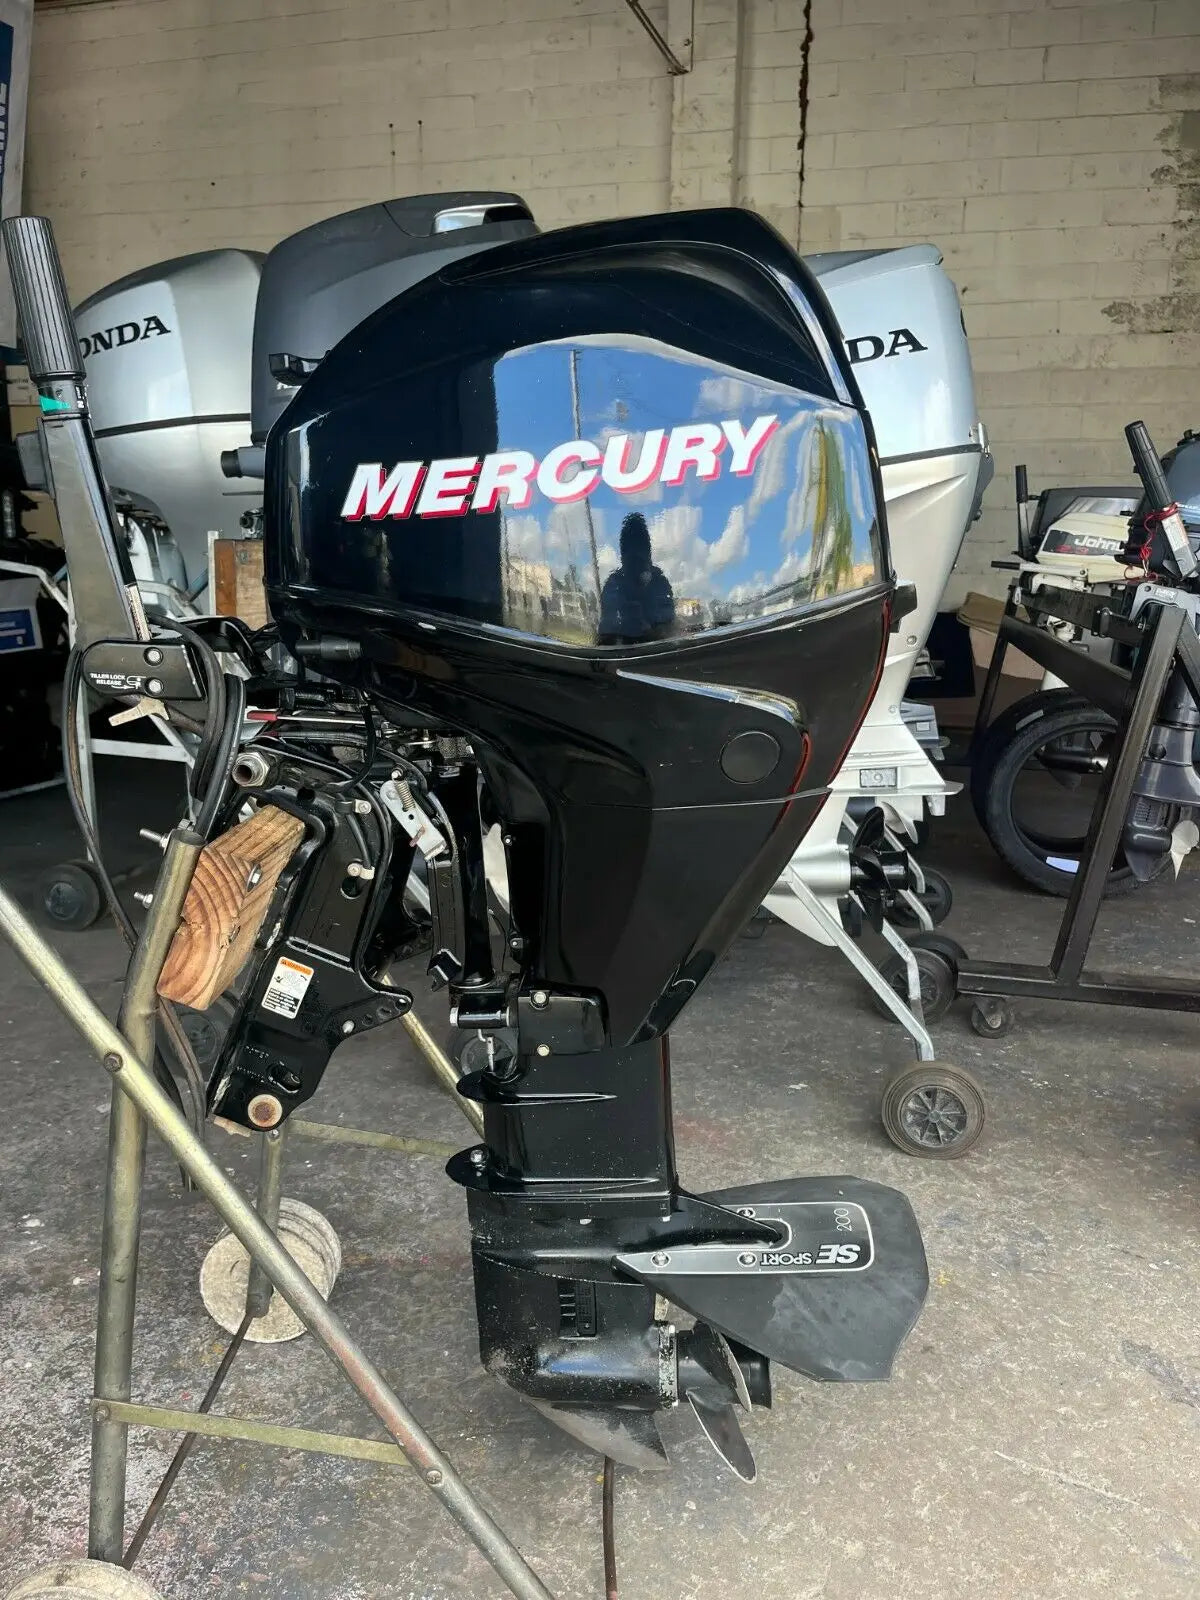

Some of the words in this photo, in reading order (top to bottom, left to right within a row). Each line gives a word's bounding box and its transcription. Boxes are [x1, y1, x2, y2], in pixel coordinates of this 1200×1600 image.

[340, 414, 780, 522] MERCURY
[833, 1207, 853, 1232] 200
[760, 1251, 813, 1266] SPORT
[816, 1243, 861, 1264] SE
